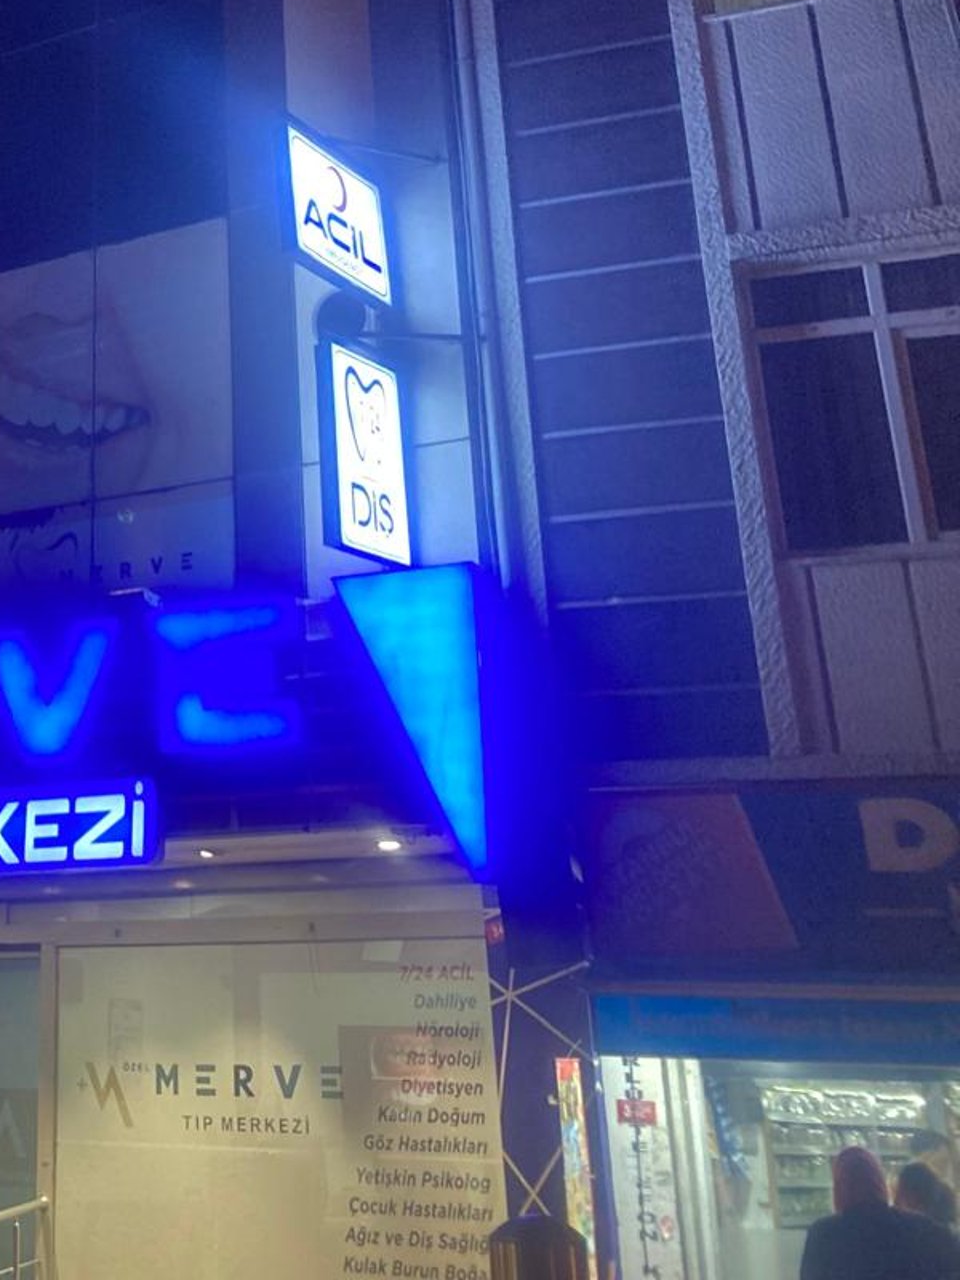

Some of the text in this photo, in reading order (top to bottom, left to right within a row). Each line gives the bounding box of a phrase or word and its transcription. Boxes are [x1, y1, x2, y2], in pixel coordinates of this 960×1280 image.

[413, 992, 477, 1012] Dahiliye
[416, 1021, 480, 1041] Nöroloji
[406, 1049, 482, 1070] Radyoloji
[155, 1063, 345, 1099] MERVE
[401, 1078, 484, 1098] Diyetisyen
[182, 1114, 311, 1135] TIP MERKEZİ
[378, 1104, 486, 1127] Kadın Doğum
[363, 1133, 489, 1156] Göz Hastalıkları
[356, 1167, 492, 1194] Yetişkin Psikolog
[348, 1196, 494, 1223] Çocuk Hastalıkları
[344, 1225, 381, 1247] Ağız
[384, 1233, 405, 1247] ve
[437, 1231, 490, 1256] Sağlığ
[343, 1255, 488, 1280] Kulak Burun Boğa
